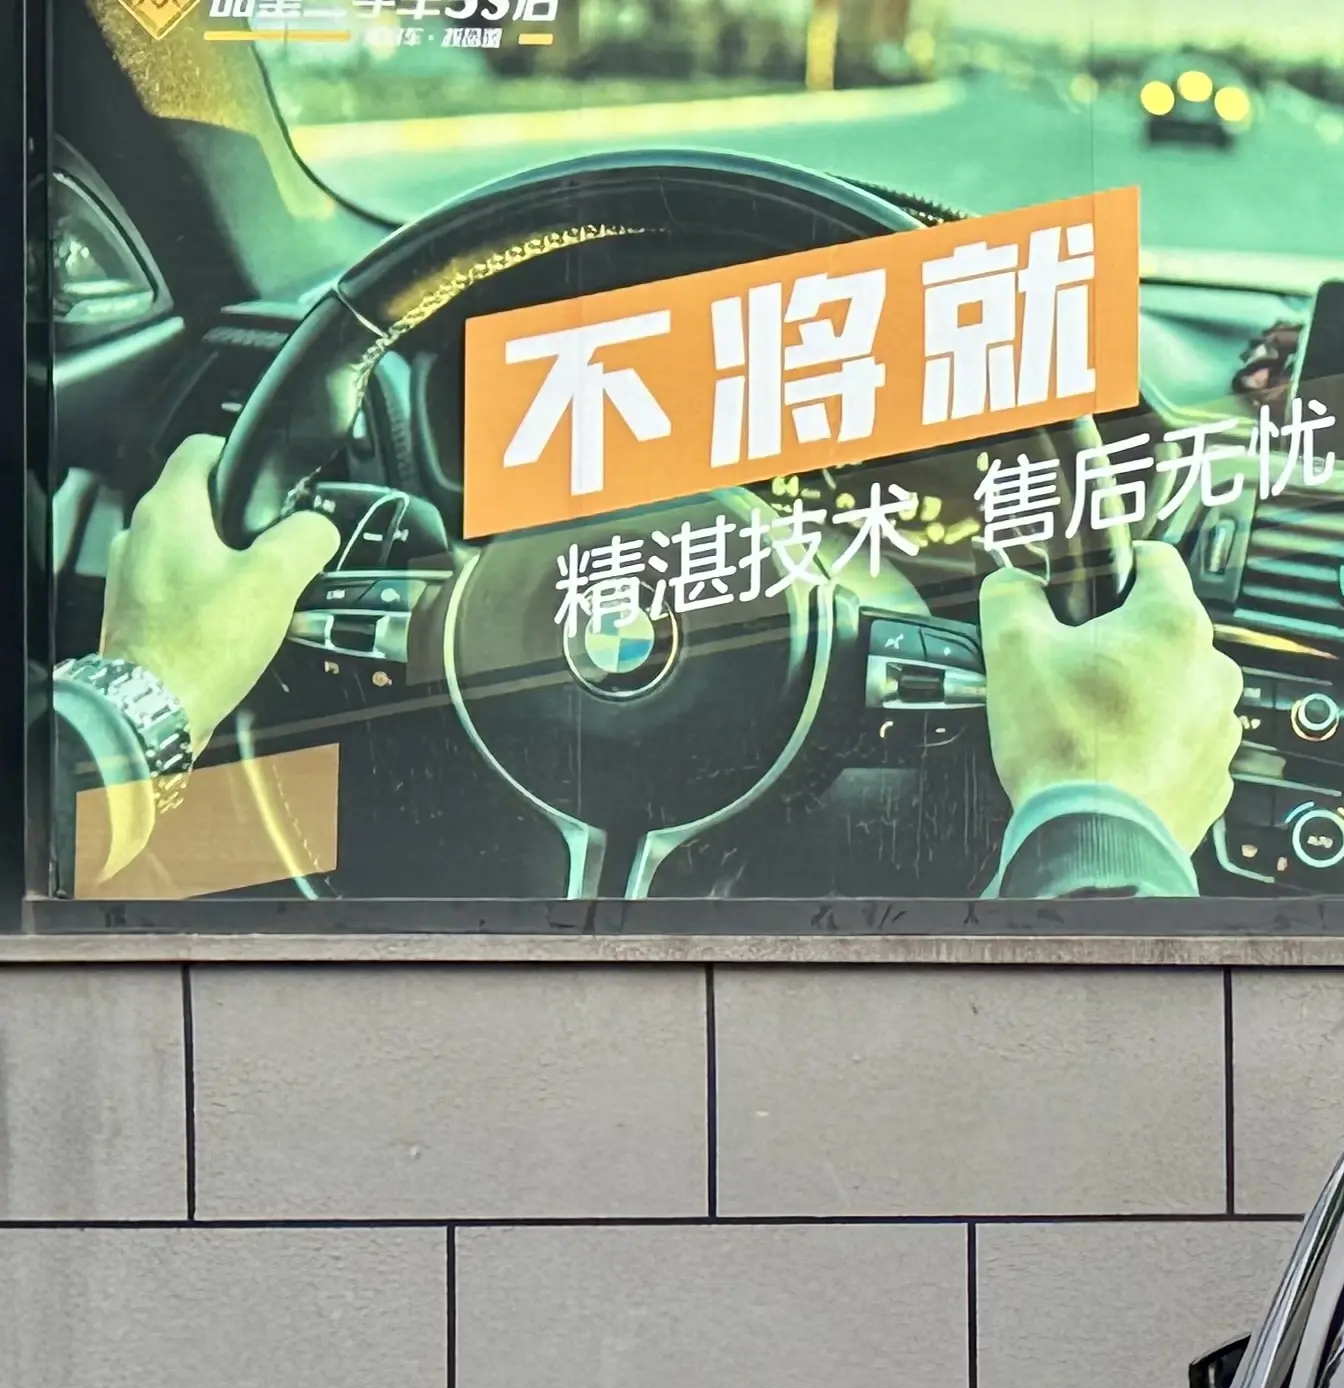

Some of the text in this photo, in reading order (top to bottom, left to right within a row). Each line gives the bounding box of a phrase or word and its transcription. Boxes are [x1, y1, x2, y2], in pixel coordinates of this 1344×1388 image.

[502, 221, 1096, 497] 不将就
[554, 397, 1336, 638] 精湛技术 售后无忧
